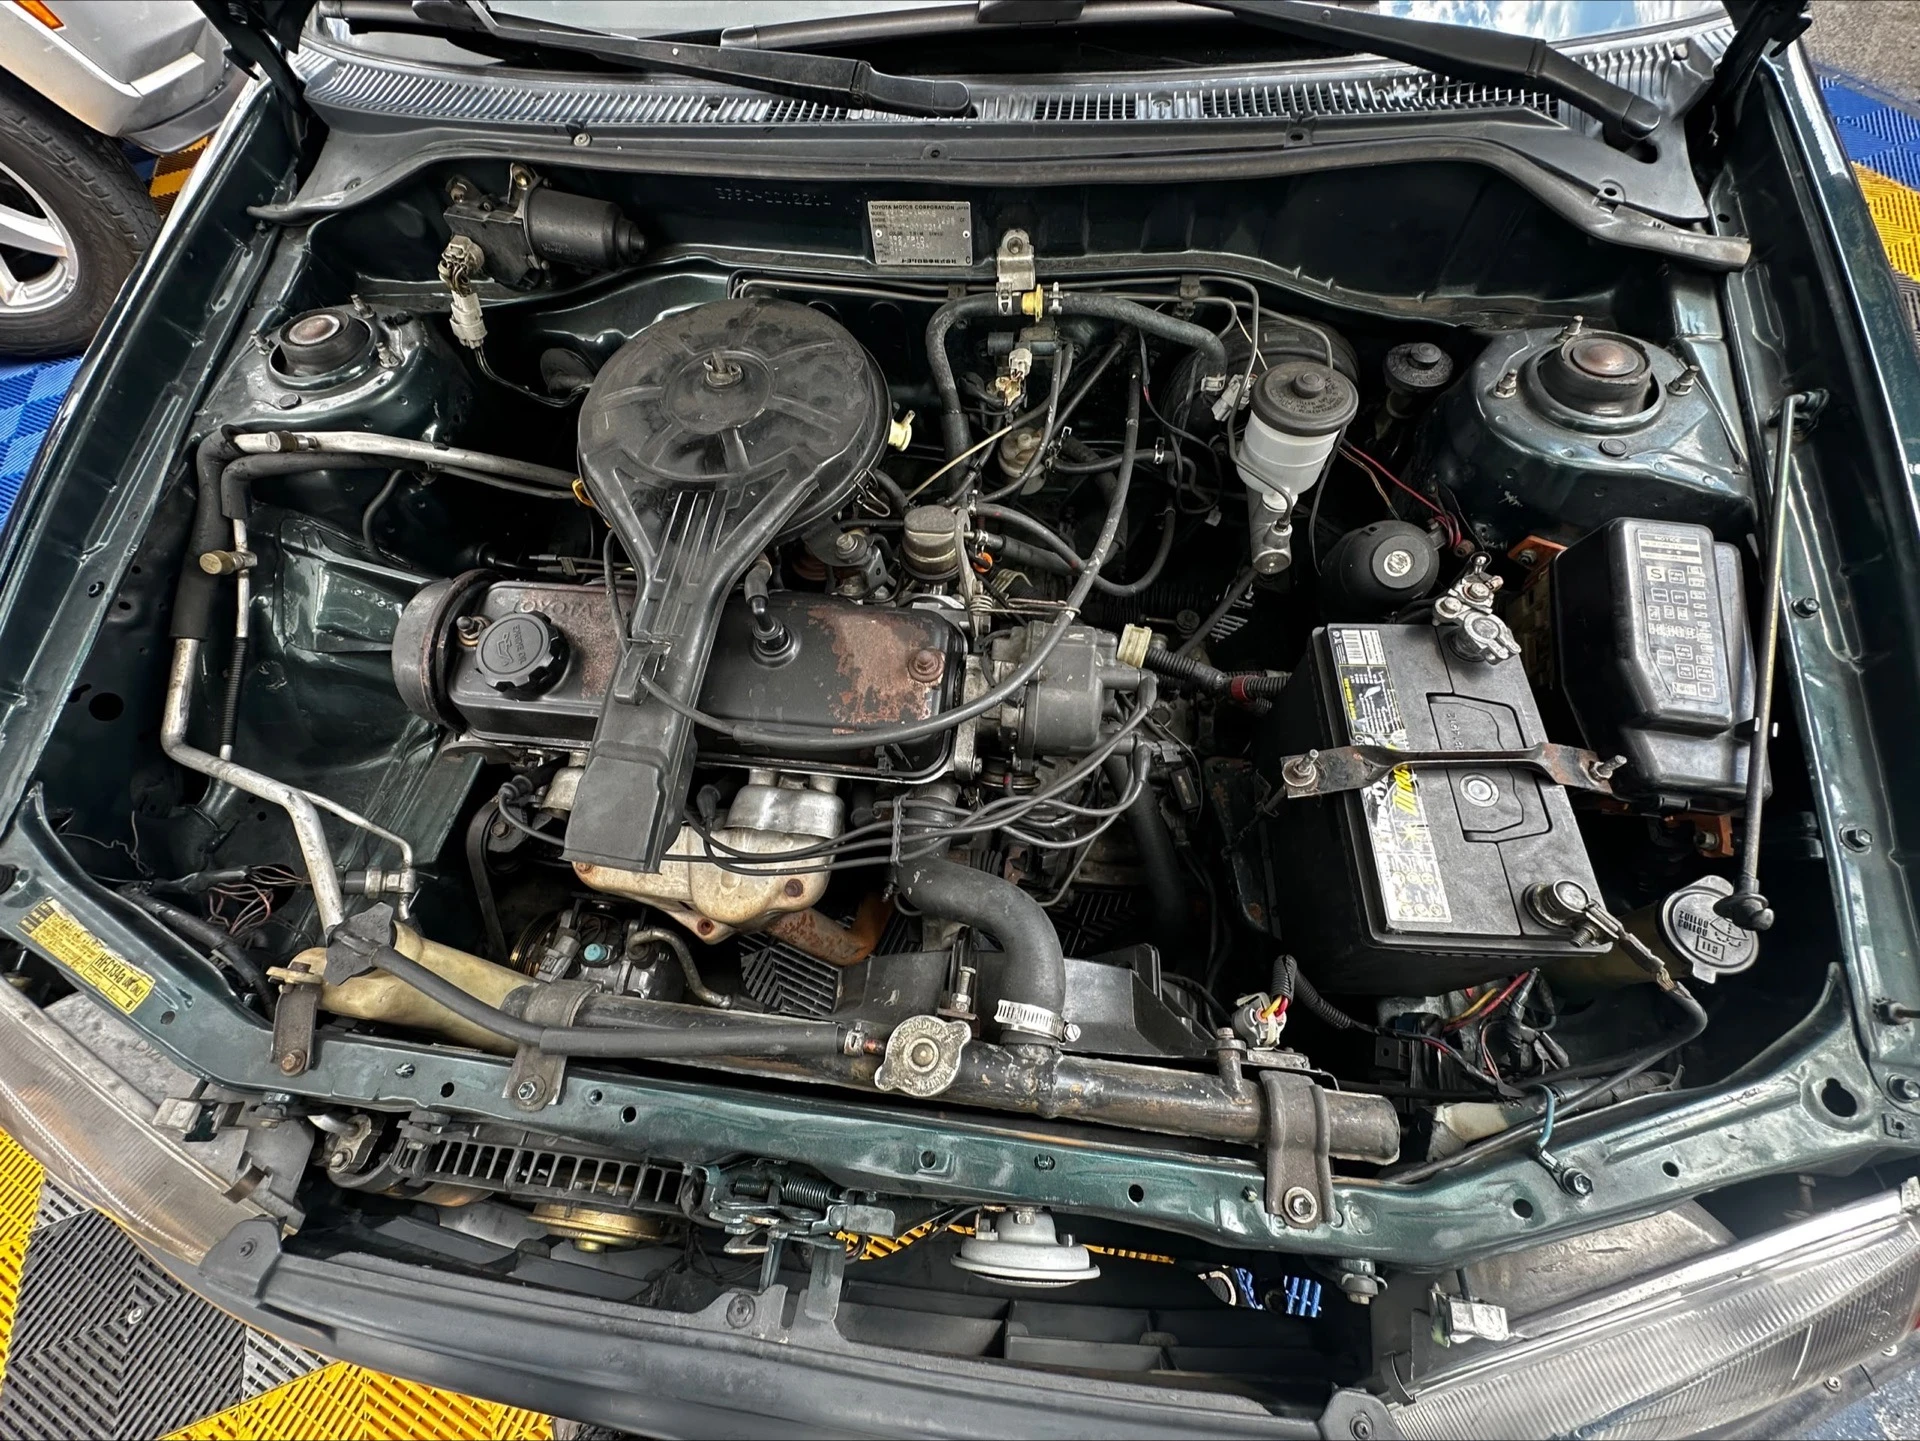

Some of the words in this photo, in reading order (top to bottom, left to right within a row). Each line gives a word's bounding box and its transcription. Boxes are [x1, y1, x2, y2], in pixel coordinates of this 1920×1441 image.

[1650, 568, 1662, 579] S
[512, 624, 525, 655] ENGINE
[517, 652, 528, 665] OIL
[94, 952, 126, 984] HFC134a
